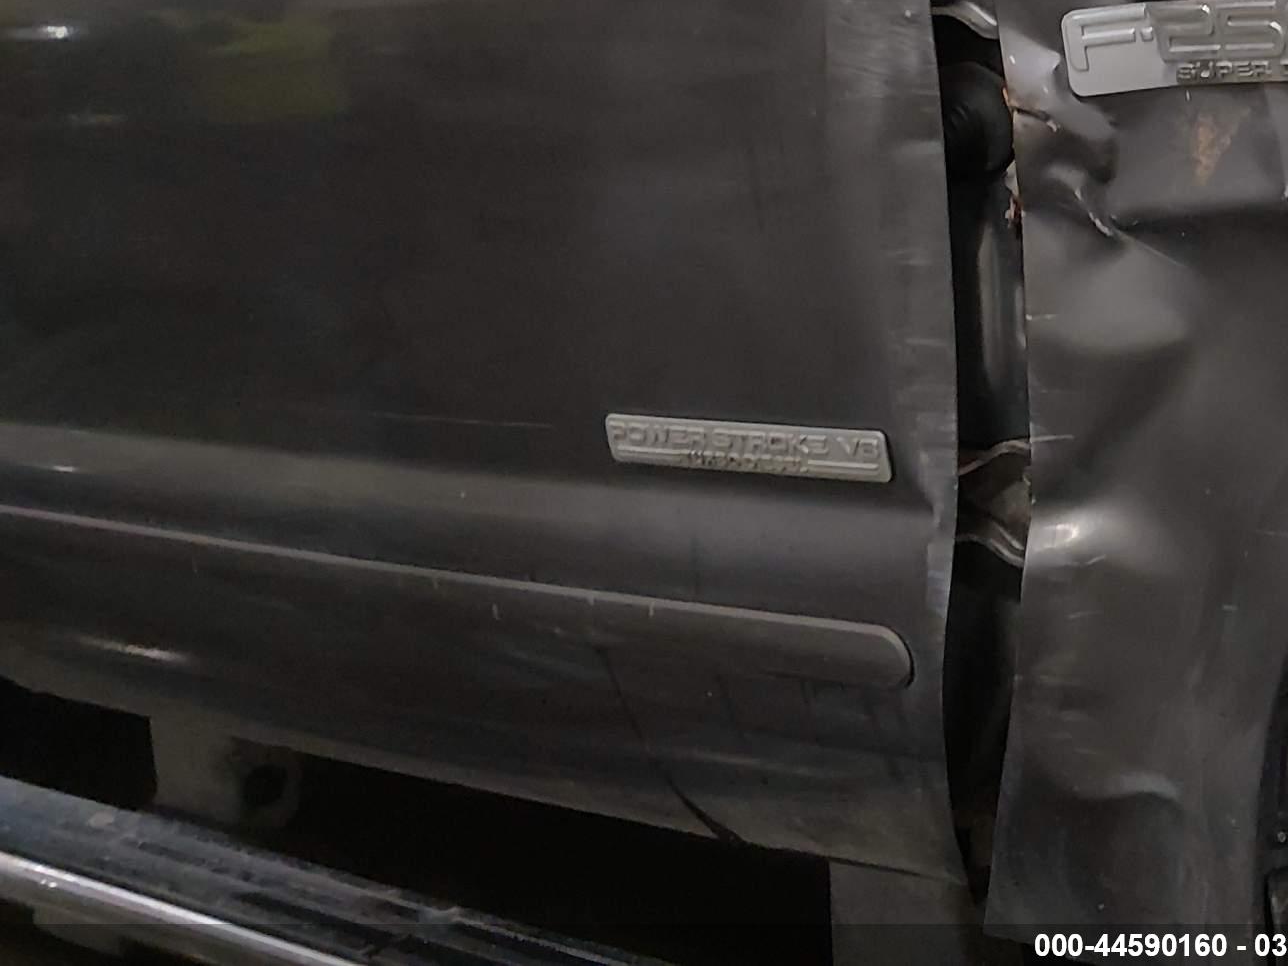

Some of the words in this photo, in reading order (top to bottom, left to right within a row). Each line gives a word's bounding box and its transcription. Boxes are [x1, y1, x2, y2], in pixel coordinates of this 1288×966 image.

[1177, 60, 1272, 82] SUPER
[609, 421, 706, 449] POWER
[712, 428, 830, 456] STROKE
[837, 435, 879, 459] V8
